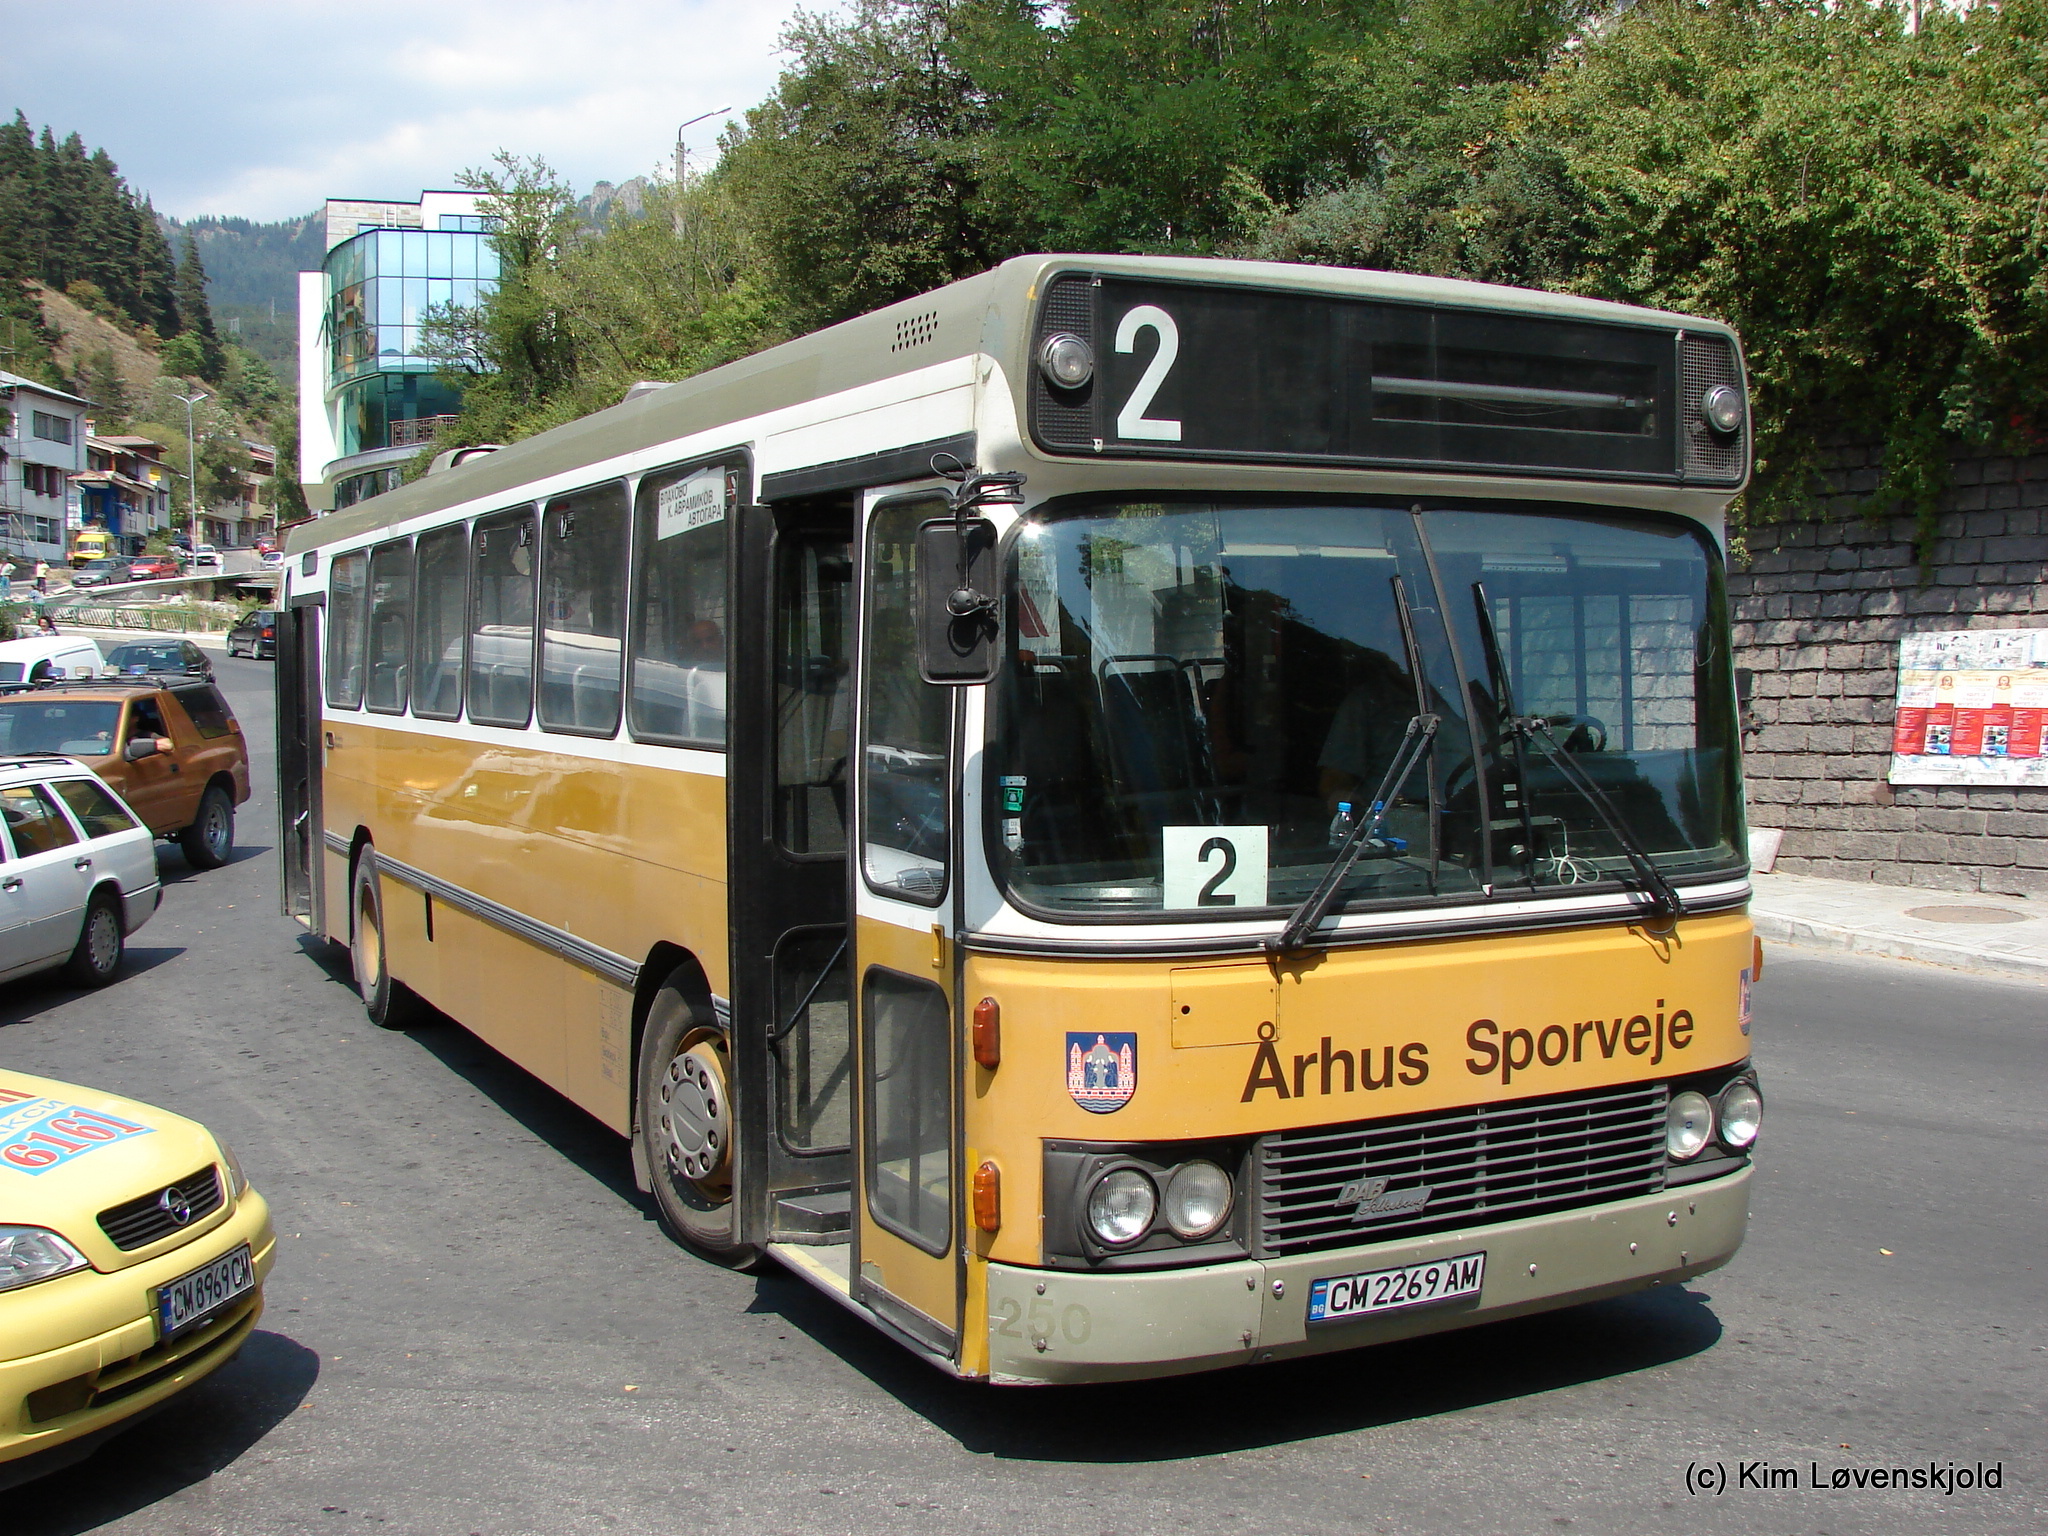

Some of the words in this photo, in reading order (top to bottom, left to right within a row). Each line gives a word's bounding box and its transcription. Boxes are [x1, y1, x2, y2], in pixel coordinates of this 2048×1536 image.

[1115, 305, 1182, 441] 2
[674, 489, 713, 516] АВРАМИКОВ
[687, 504, 722, 526] АВТОГАРА
[1197, 837, 1236, 907] 2
[1241, 1020, 1429, 1103] Århus
[1465, 999, 1694, 1086] Sporveje
[4, 1110, 145, 1167] 6161
[1341, 1179, 1386, 1203] DAB
[174, 1281, 194, 1320] CM
[196, 1263, 229, 1309] 8969
[231, 1251, 251, 1288] CM
[1312, 1304, 1325, 1314] BG
[1330, 1278, 1369, 1312] CM
[1372, 1267, 1440, 1306] 2269
[1443, 1258, 1479, 1293] AM
[998, 1296, 1092, 1345] 250
